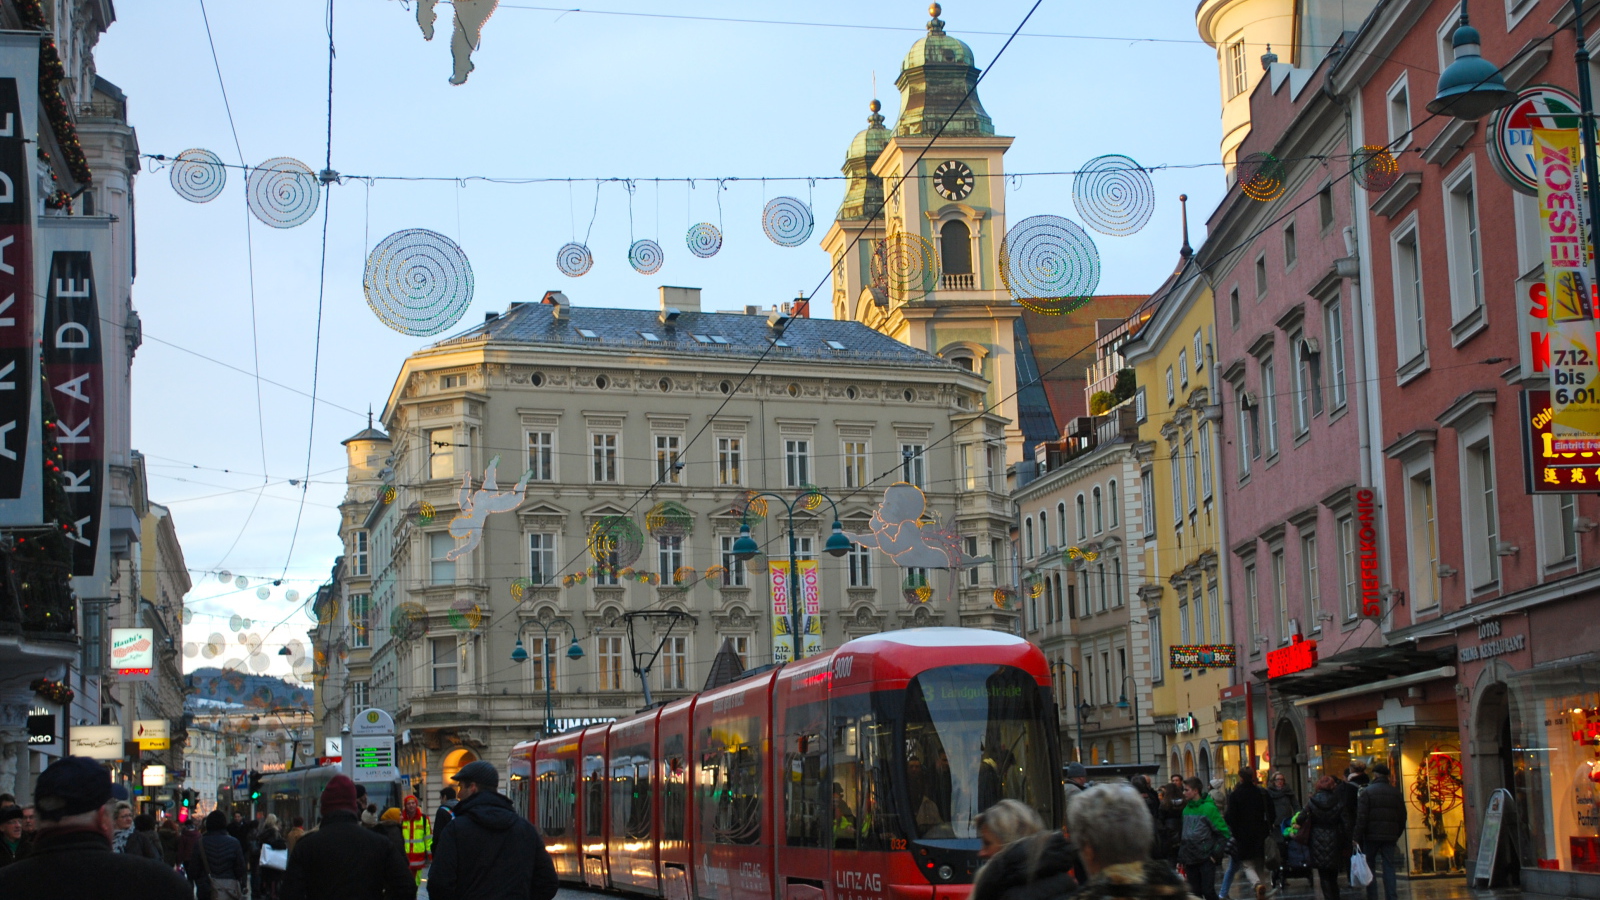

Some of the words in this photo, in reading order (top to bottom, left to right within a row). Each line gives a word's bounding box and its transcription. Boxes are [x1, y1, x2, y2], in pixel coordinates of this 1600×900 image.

[1574, 174, 1582, 201] mitten
[1554, 349, 1593, 366] 7.12.
[1555, 369, 1585, 385] bis
[54, 278, 91, 547] ARKADE
[1554, 441, 1585, 450] Eintritt
[1478, 621, 1500, 639] LOTOS
[1479, 634, 1525, 659] RESTAURANT
[1174, 653, 1198, 664] Paper
[1214, 652, 1231, 661] Box
[921, 685, 935, 702] 3
[836, 870, 862, 890] LINZ
[864, 873, 881, 892] AG
